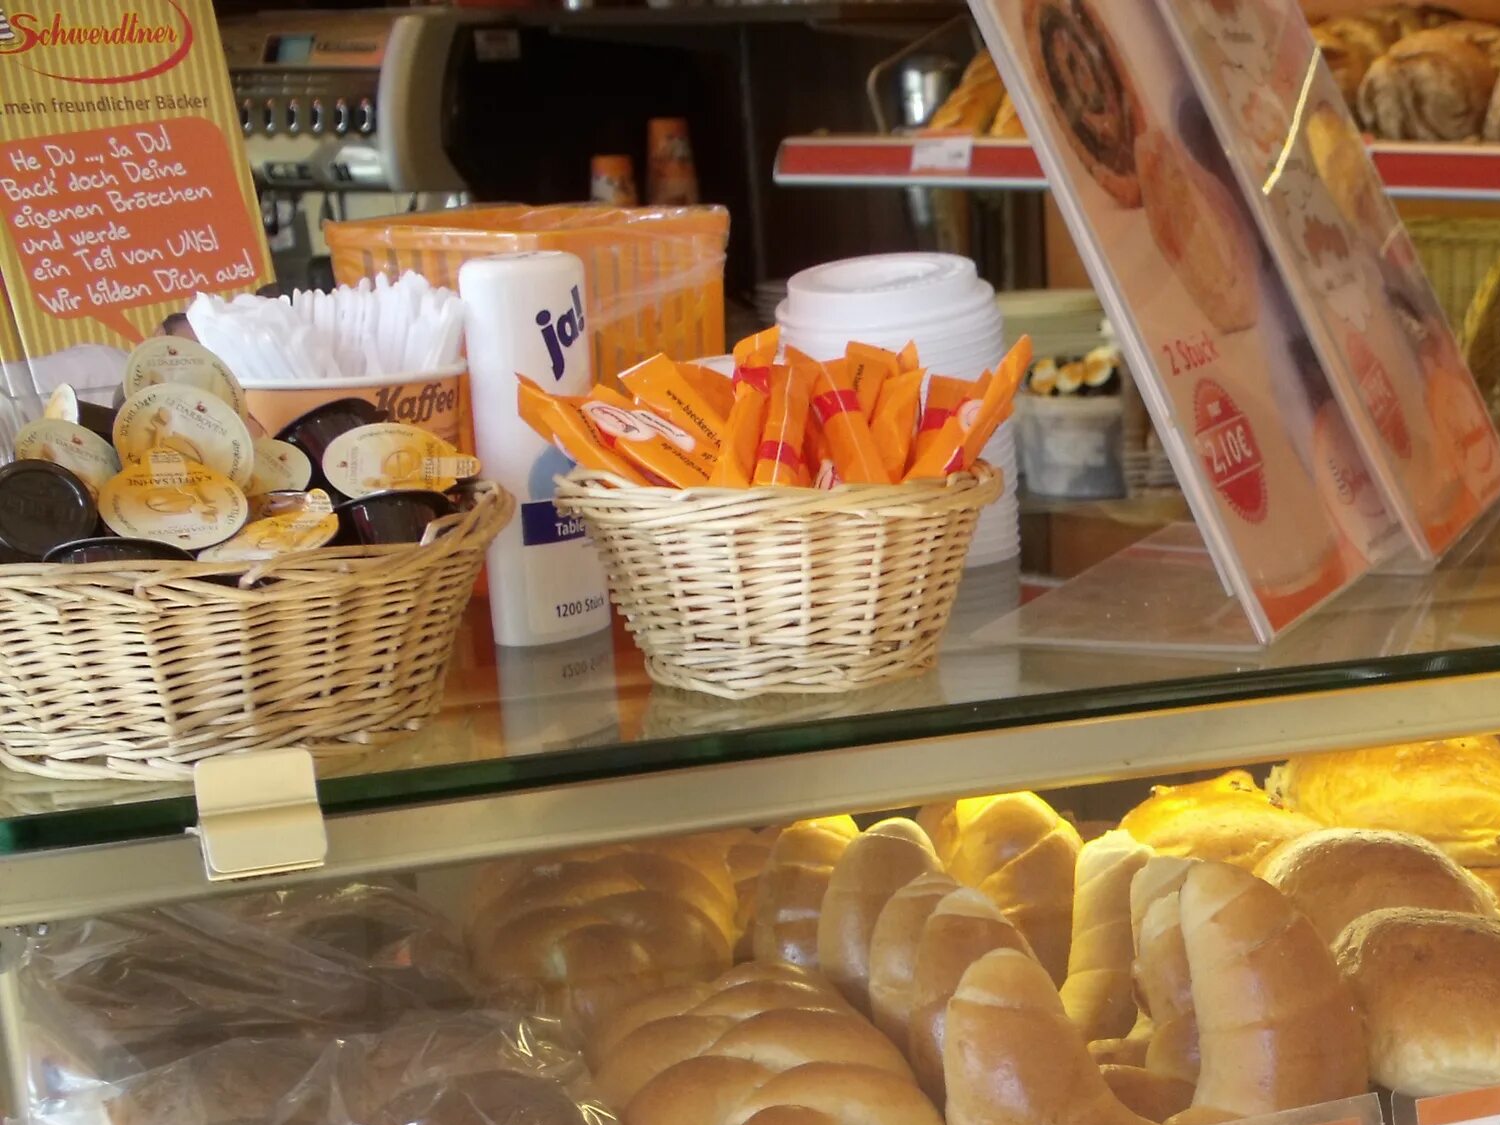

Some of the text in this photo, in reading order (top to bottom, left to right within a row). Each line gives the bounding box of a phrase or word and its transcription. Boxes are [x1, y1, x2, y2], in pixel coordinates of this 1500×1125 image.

[9, 12, 178, 52] Schwerdtner
[52, 97, 151, 114] freundlicher
[157, 94, 209, 110] Bäcker
[10, 150, 41, 172] He
[45, 144, 76, 167] Du
[136, 124, 172, 154] Du!
[69, 171, 119, 192] doch
[123, 159, 187, 184] Deine
[14, 185, 212, 231] eigenen Brötchen
[23, 221, 131, 255] und werde
[33, 259, 71, 282] ein
[73, 244, 117, 273] Teil
[123, 246, 164, 266] von
[38, 247, 256, 314] Wir bilden Dich aus!
[535, 284, 586, 382] ja!
[374, 382, 457, 424] Kaffee
[1203, 423, 1254, 477] 2,10€
[556, 599, 583, 619] 1200
